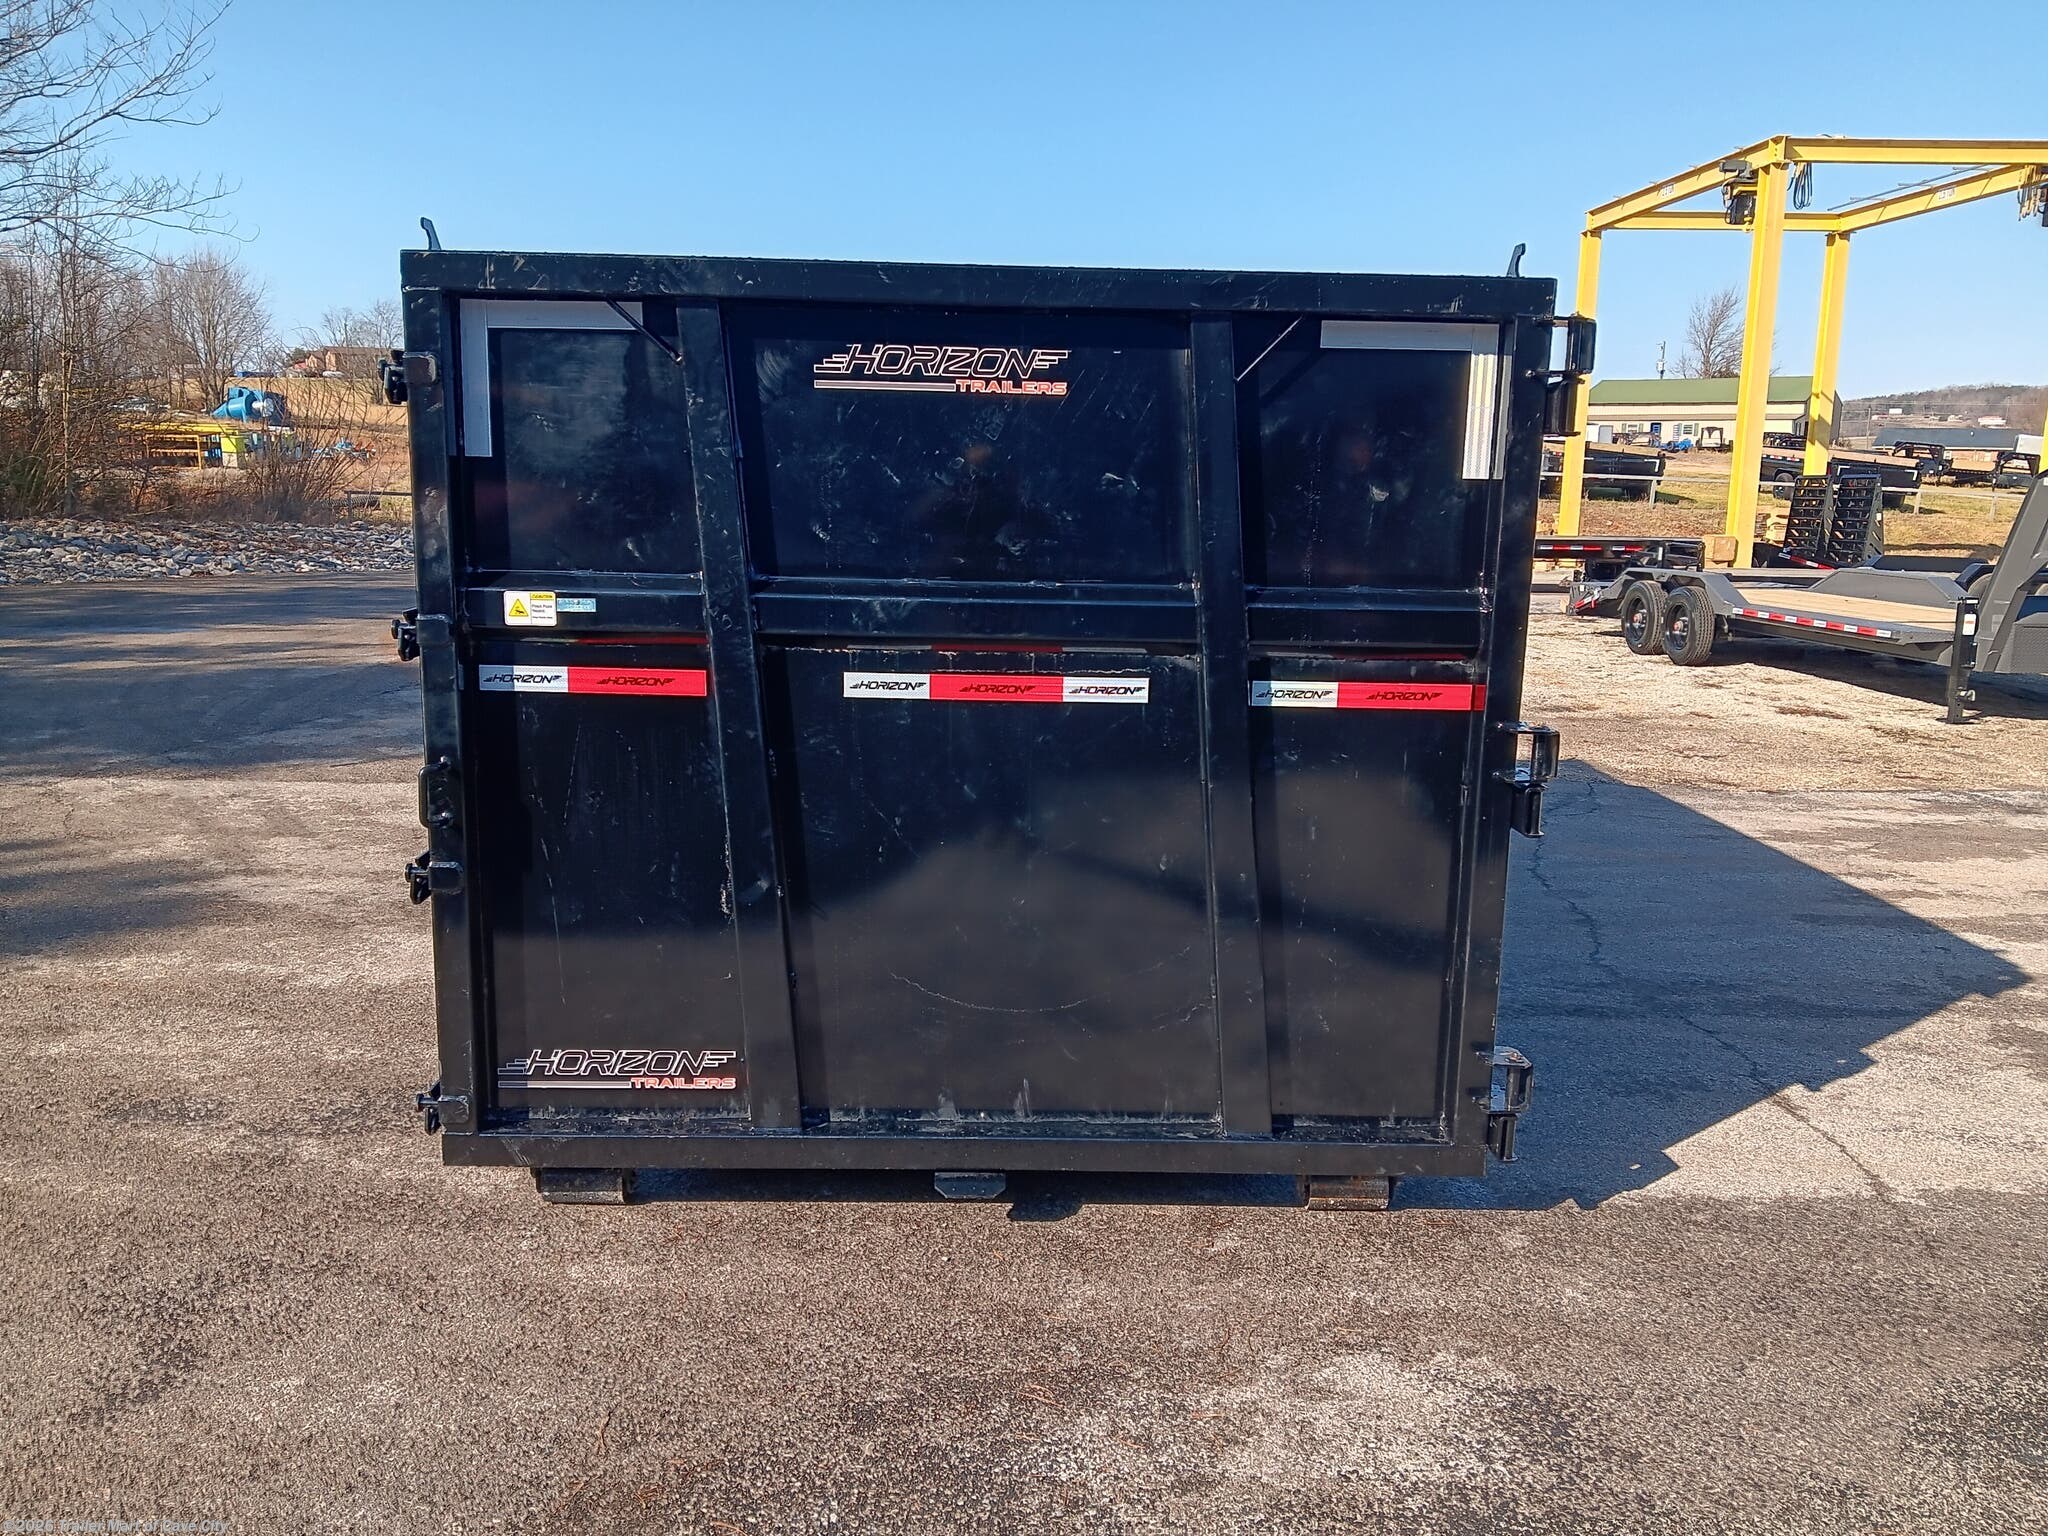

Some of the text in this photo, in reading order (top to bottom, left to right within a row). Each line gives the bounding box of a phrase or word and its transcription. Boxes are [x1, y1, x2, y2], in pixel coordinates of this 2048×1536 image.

[844, 343, 1039, 379] HORIZON
[955, 379, 1068, 395] TRAILERS
[493, 673, 667, 686] HORIZON HORIZON
[859, 680, 1137, 695] HORIZON HORIZON HORIZON
[1265, 689, 1435, 701] HORIZON HORIZON
[526, 1049, 708, 1075] HORIZON
[631, 1077, 737, 1089] TRAILERS
